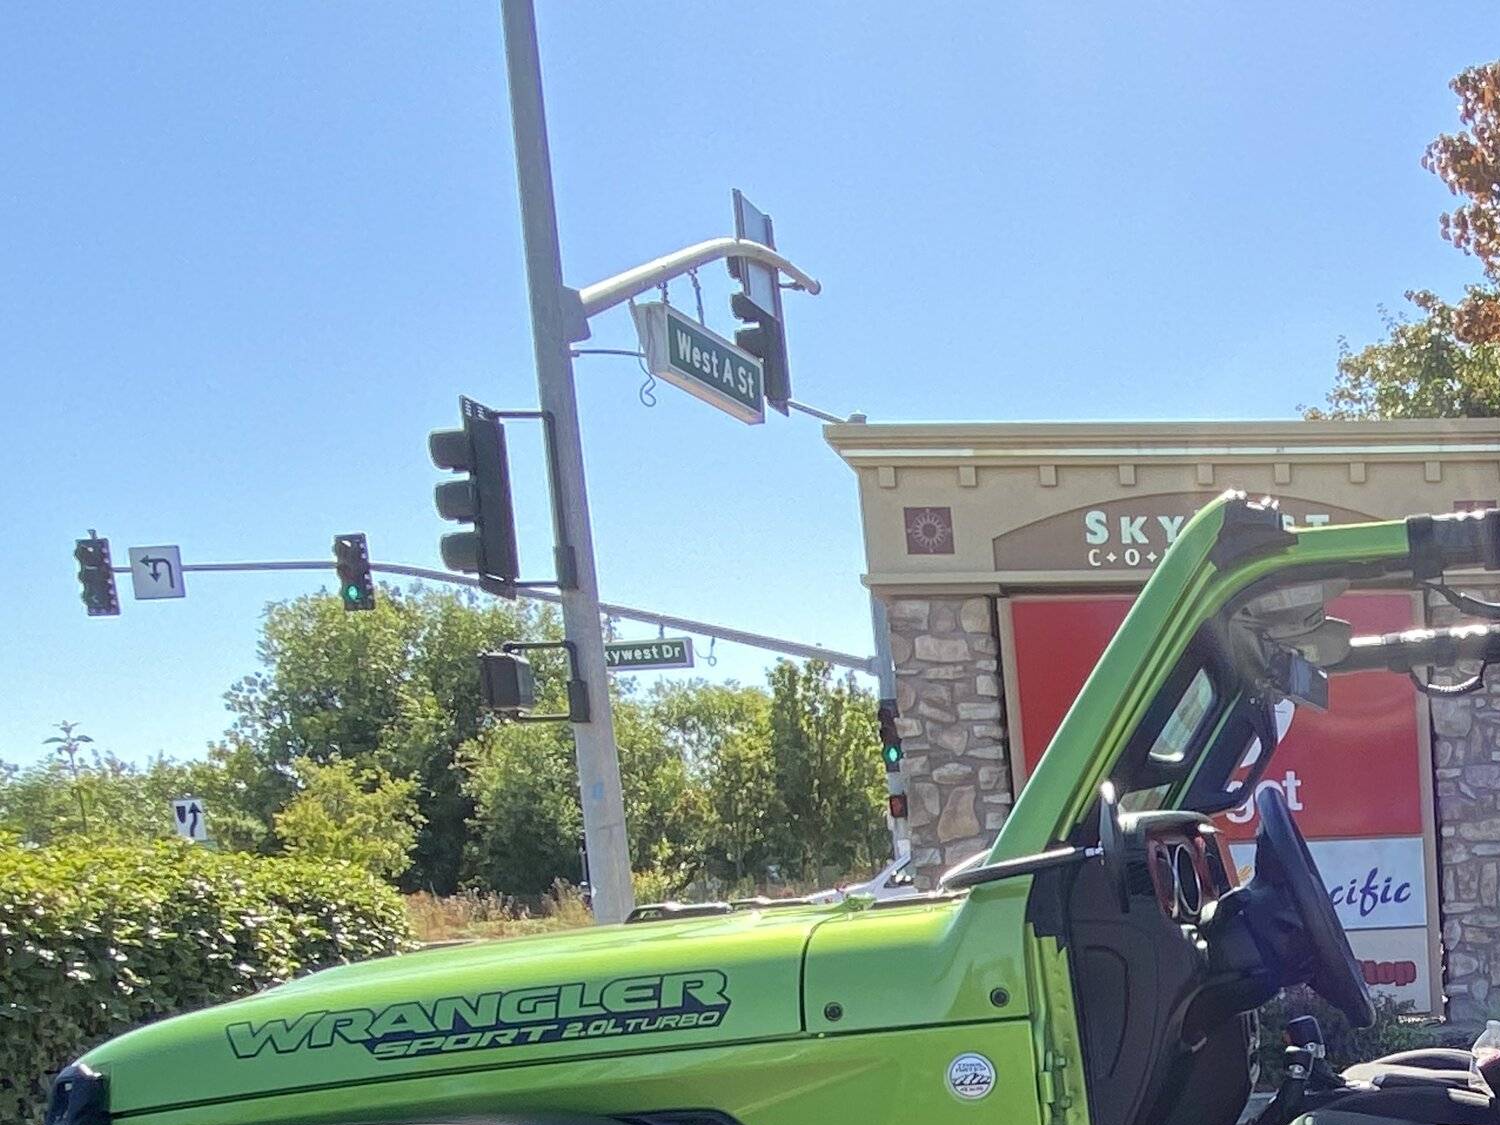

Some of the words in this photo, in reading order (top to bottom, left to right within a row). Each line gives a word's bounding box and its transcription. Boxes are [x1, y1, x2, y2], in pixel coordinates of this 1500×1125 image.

[676, 330, 719, 378] West
[723, 359, 734, 387] A
[738, 366, 755, 399] St
[662, 645, 681, 658] Dr
[1329, 867, 1412, 917] cific
[226, 969, 732, 1059] WRANGLER
[374, 1024, 559, 1058] SPORT
[561, 1021, 624, 1039] 2.0L
[625, 1010, 721, 1031] TURBO
